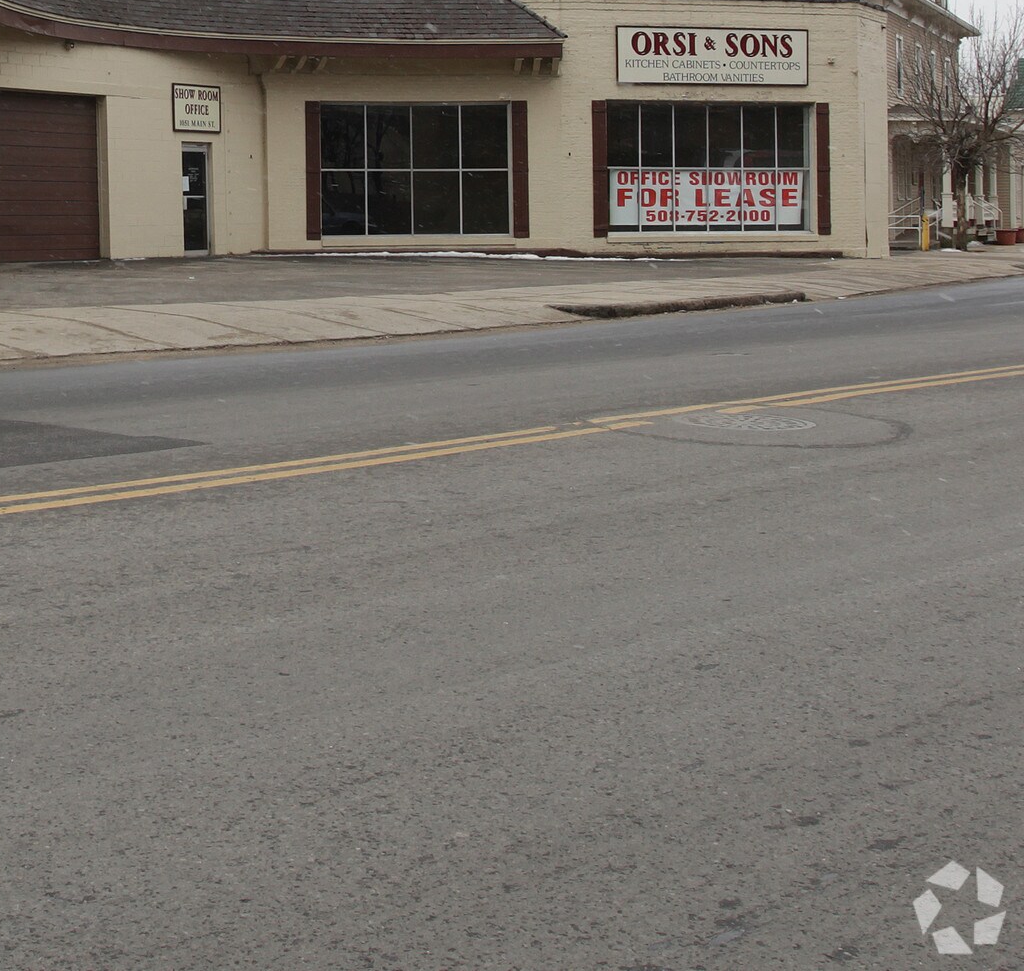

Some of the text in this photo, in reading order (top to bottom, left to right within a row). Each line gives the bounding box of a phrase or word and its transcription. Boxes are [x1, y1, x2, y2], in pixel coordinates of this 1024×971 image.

[631, 31, 793, 58] ORSI & SONS
[625, 59, 801, 71] KITCHEN CABINETS COUNTERTOPS
[663, 72, 764, 83] BATHROOM VANITIES
[175, 88, 218, 101] SHOW ROOM
[185, 103, 209, 116] OFFICE
[617, 171, 681, 186] OFFICE
[617, 188, 798, 208] FOR LEASE
[646, 209, 771, 222] 508-752-2000
